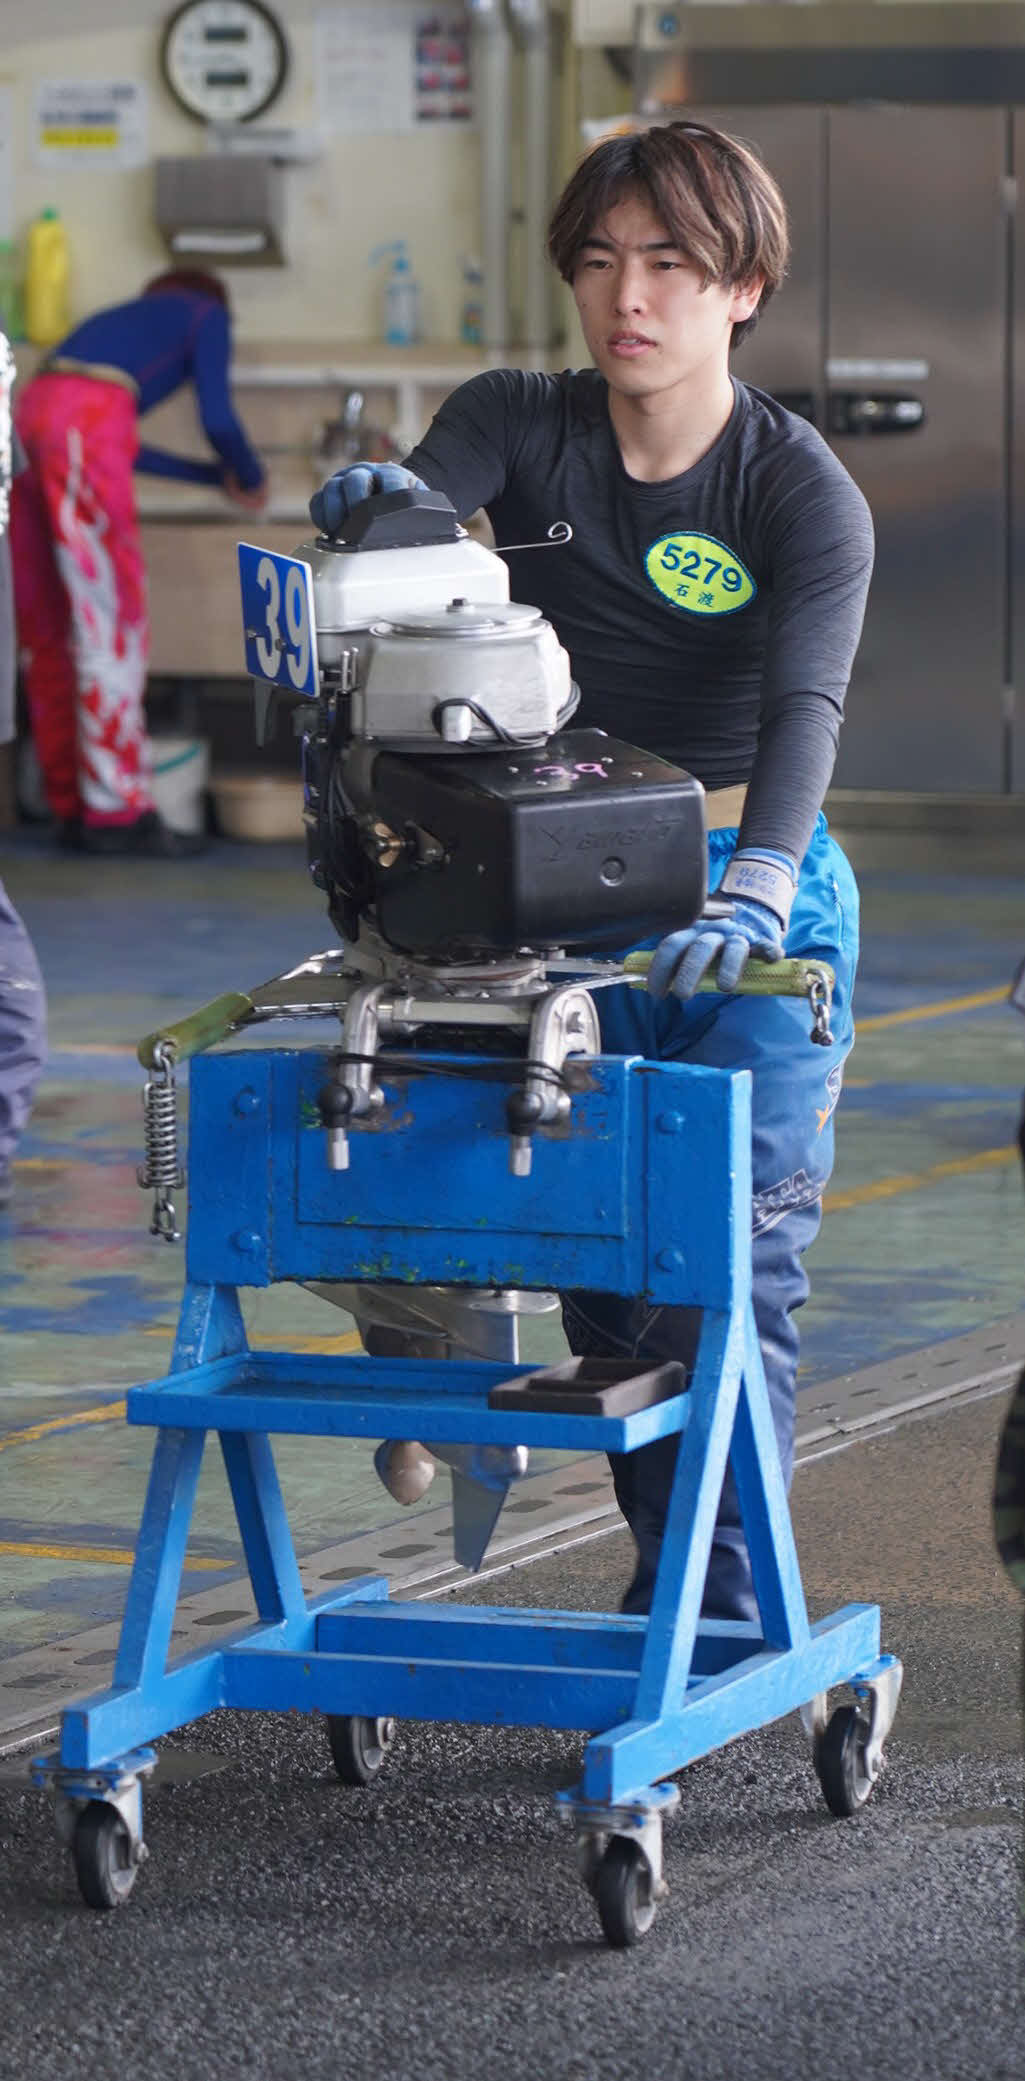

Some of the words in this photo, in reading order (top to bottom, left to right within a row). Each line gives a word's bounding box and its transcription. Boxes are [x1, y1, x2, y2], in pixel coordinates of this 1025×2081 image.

[660, 542, 743, 593] 5279
[256, 556, 311, 689] 39
[533, 762, 609, 780] 39
